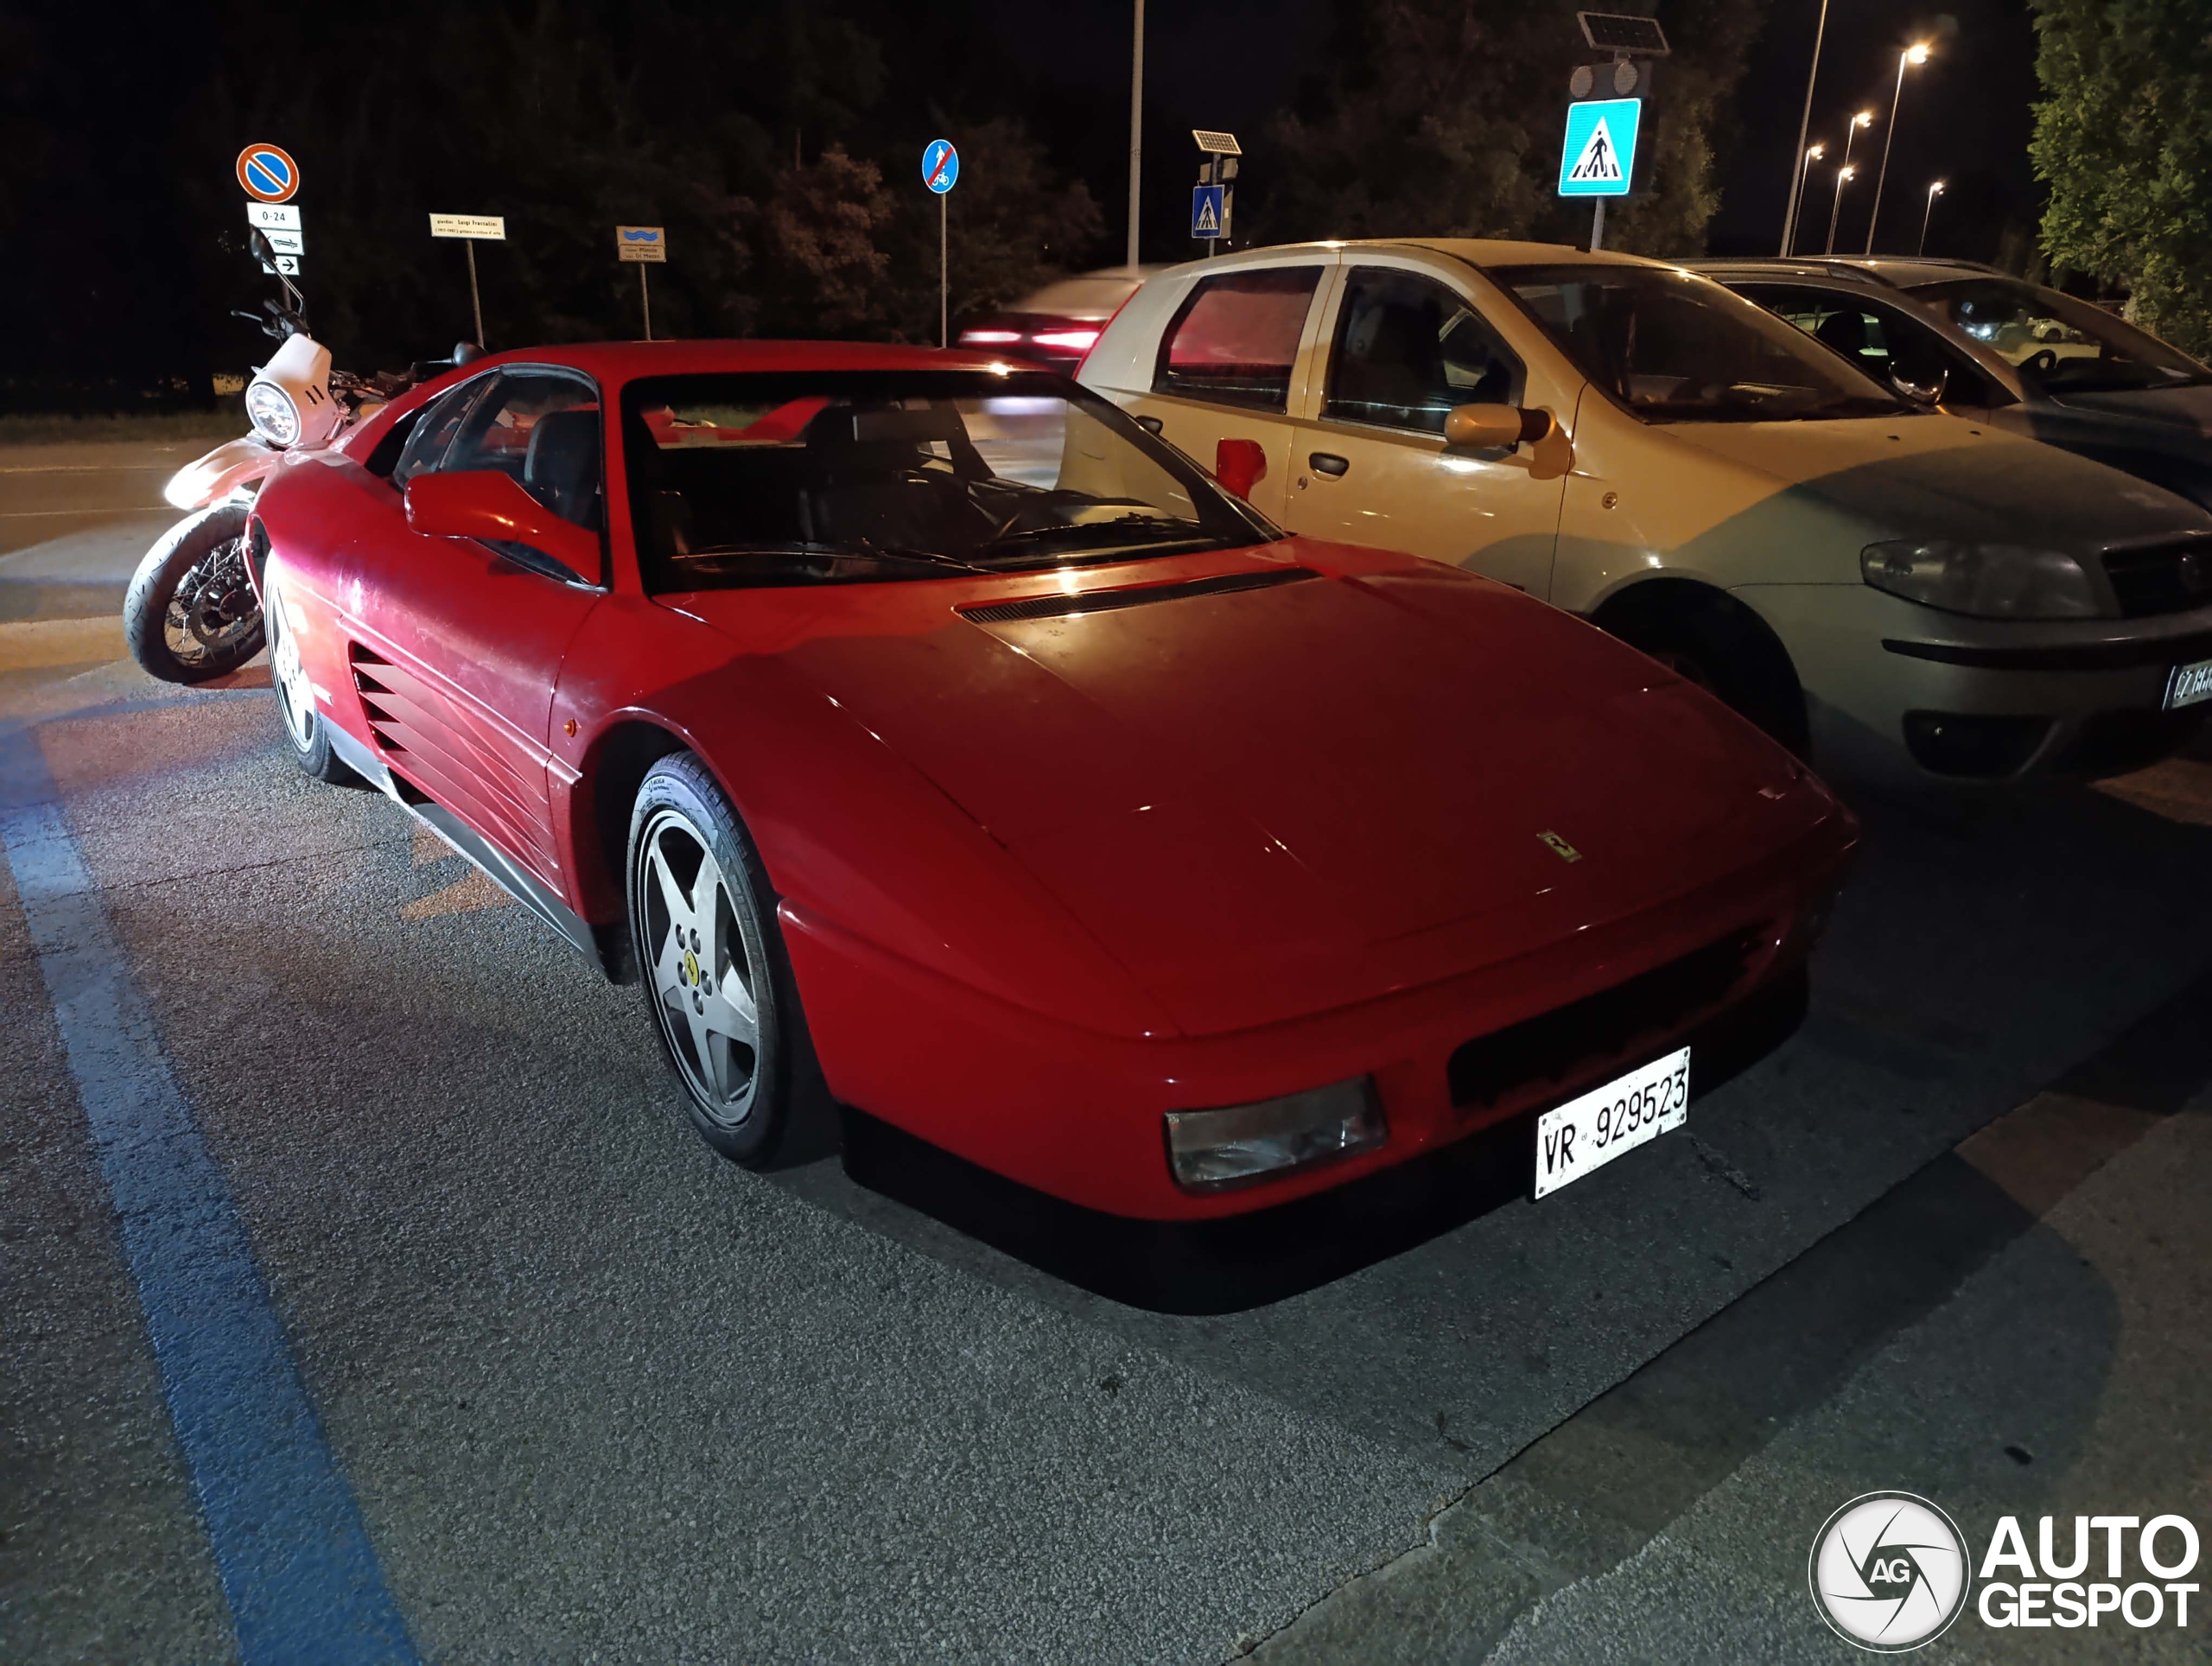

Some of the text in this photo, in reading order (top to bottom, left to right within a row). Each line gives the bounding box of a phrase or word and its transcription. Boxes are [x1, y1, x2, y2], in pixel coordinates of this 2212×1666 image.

[263, 211, 285, 221] 0-24
[1545, 1068, 1687, 1175] VR 929523
